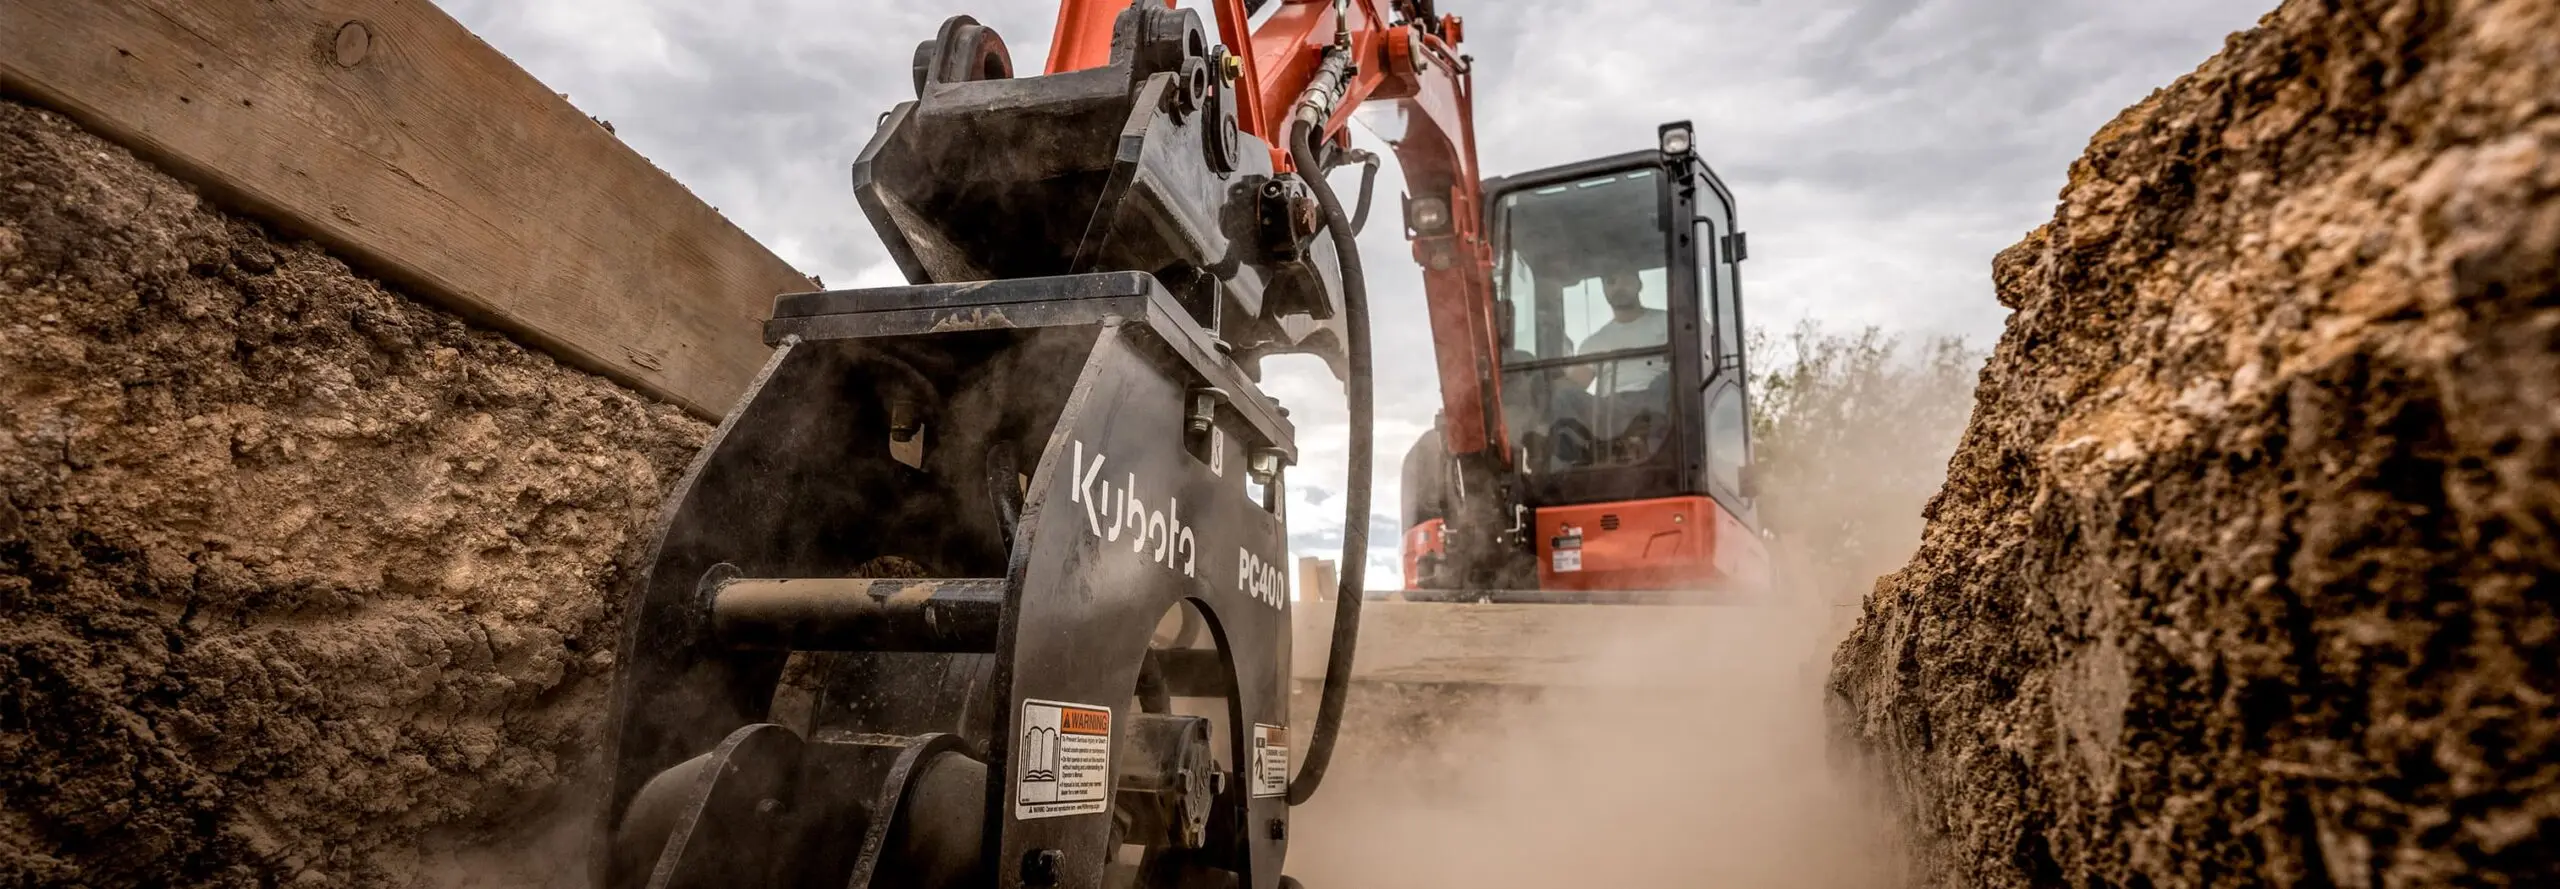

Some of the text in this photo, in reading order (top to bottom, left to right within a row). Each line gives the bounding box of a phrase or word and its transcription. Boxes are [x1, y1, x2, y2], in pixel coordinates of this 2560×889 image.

[1072, 440, 1195, 578] Kubota
[1238, 547, 1284, 611] PC400
[1072, 713, 1107, 731] WARNING
